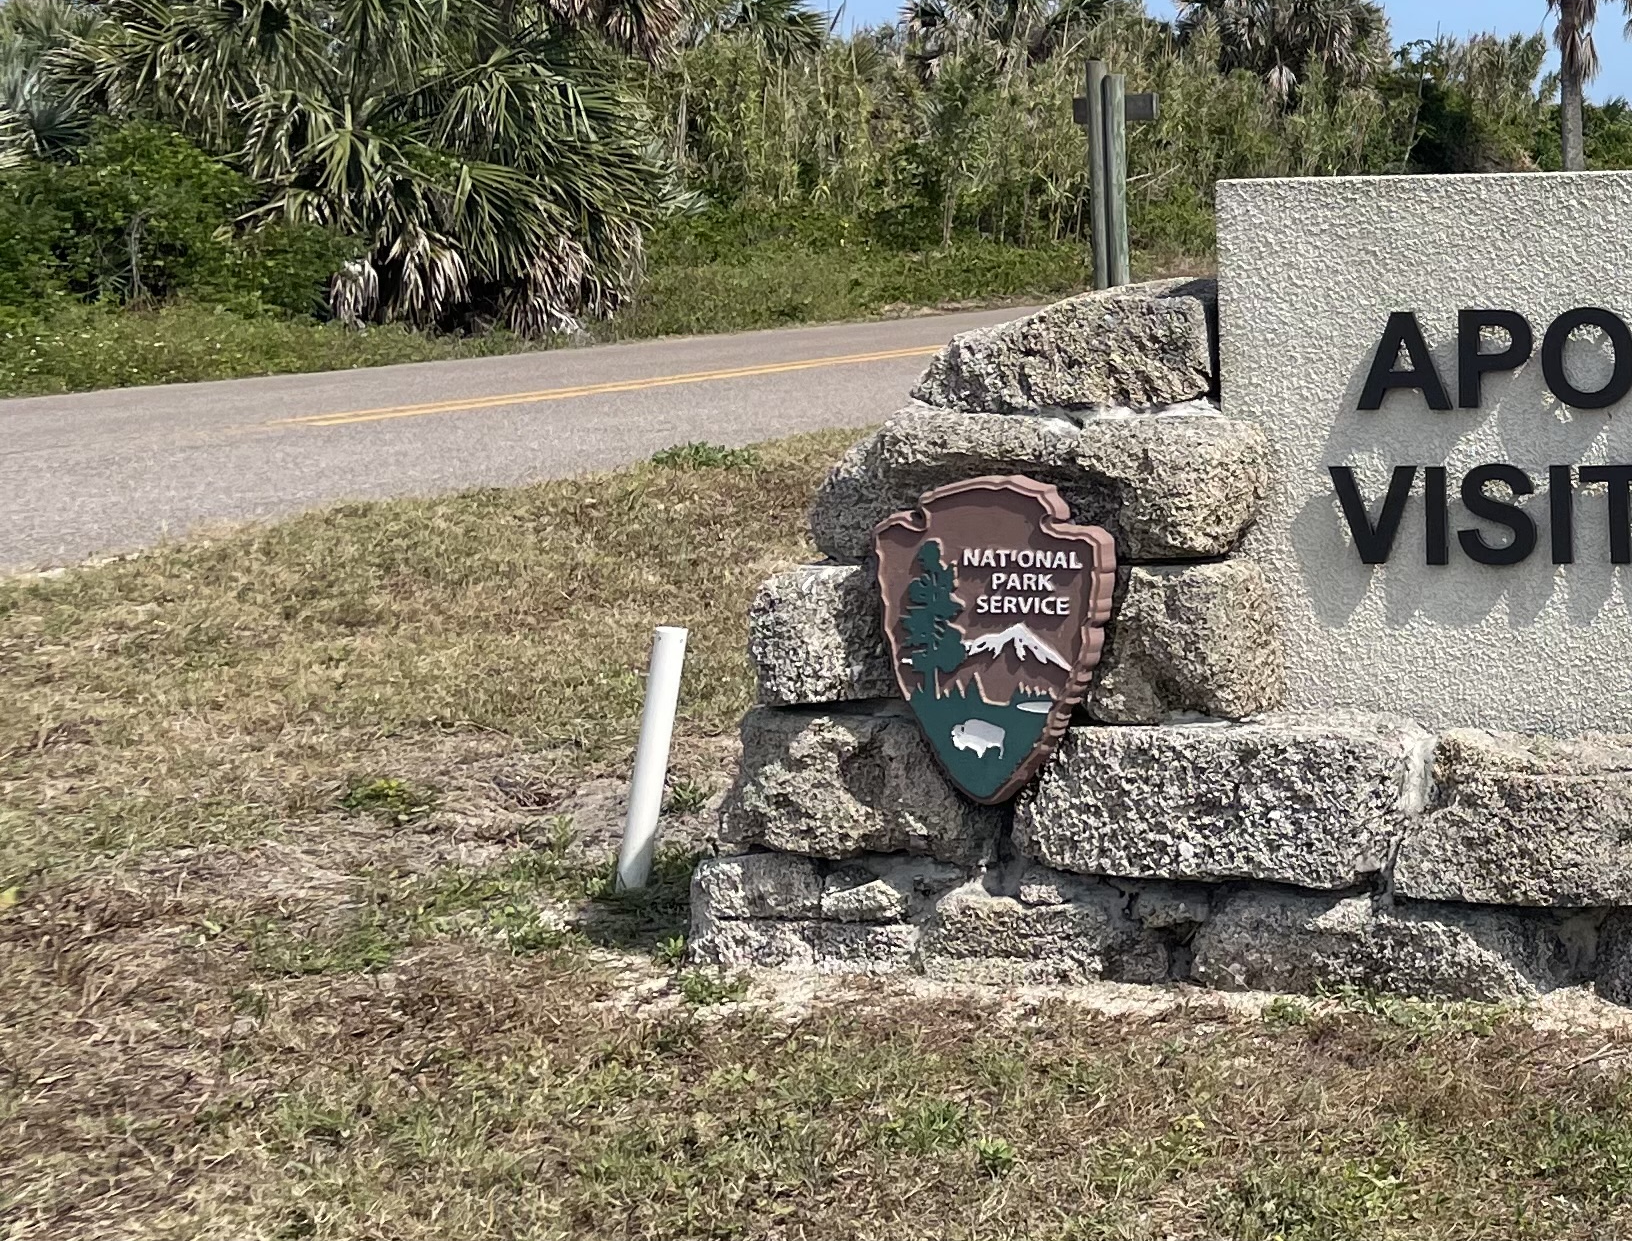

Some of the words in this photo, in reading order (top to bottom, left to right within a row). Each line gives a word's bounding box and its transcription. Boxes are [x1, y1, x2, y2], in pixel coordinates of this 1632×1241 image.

[963, 548, 1083, 570] NATIONAL
[991, 573, 1055, 592] PARK
[976, 596, 1070, 615] SERVICE
